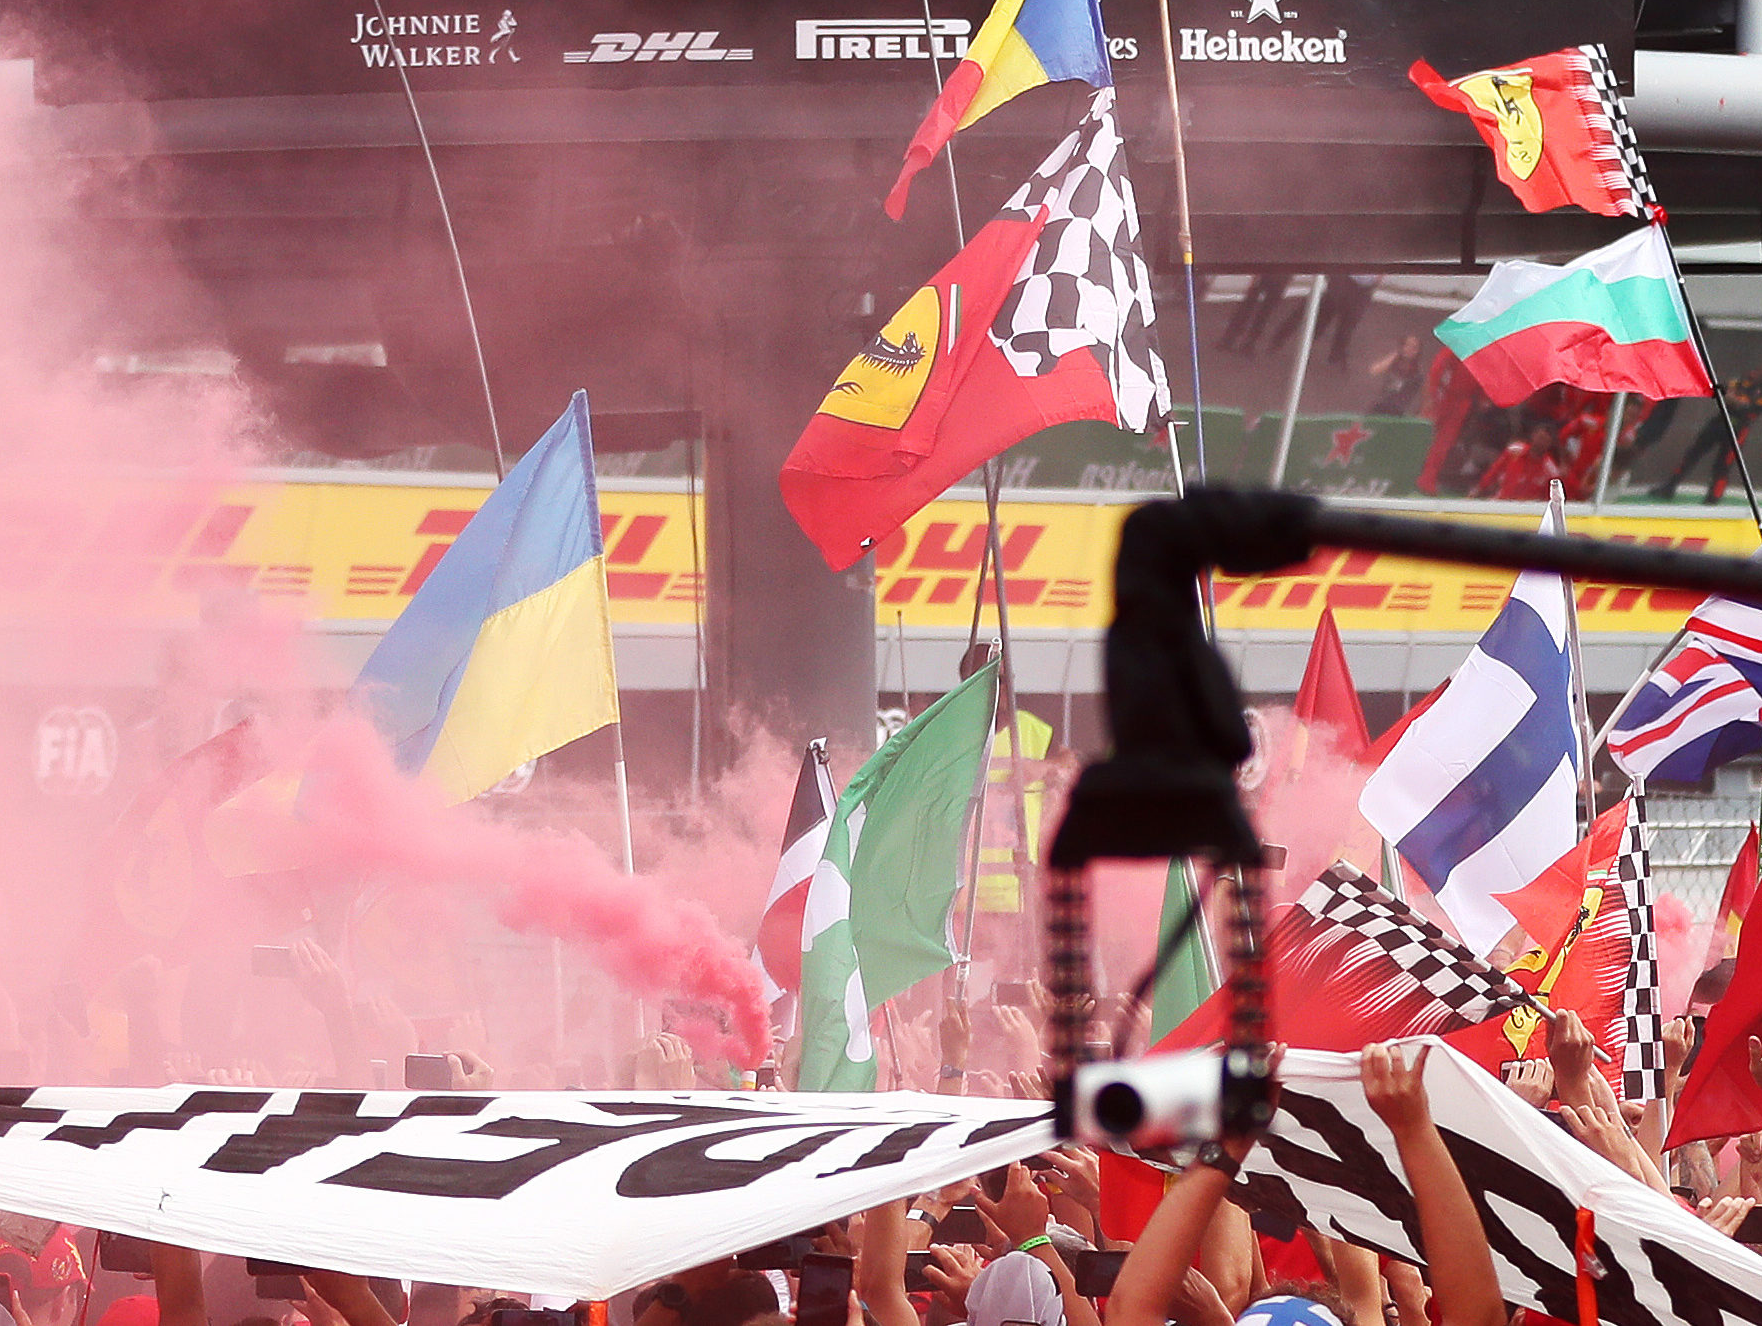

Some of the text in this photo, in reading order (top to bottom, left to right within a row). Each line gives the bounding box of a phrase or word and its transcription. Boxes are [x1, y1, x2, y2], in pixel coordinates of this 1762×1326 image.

[351, 12, 481, 45] JOHNNIE
[795, 18, 971, 60] PIRELLI
[360, 44, 481, 68] WALKER
[588, 31, 730, 63] DHL
[1179, 28, 1347, 64] Heineken
